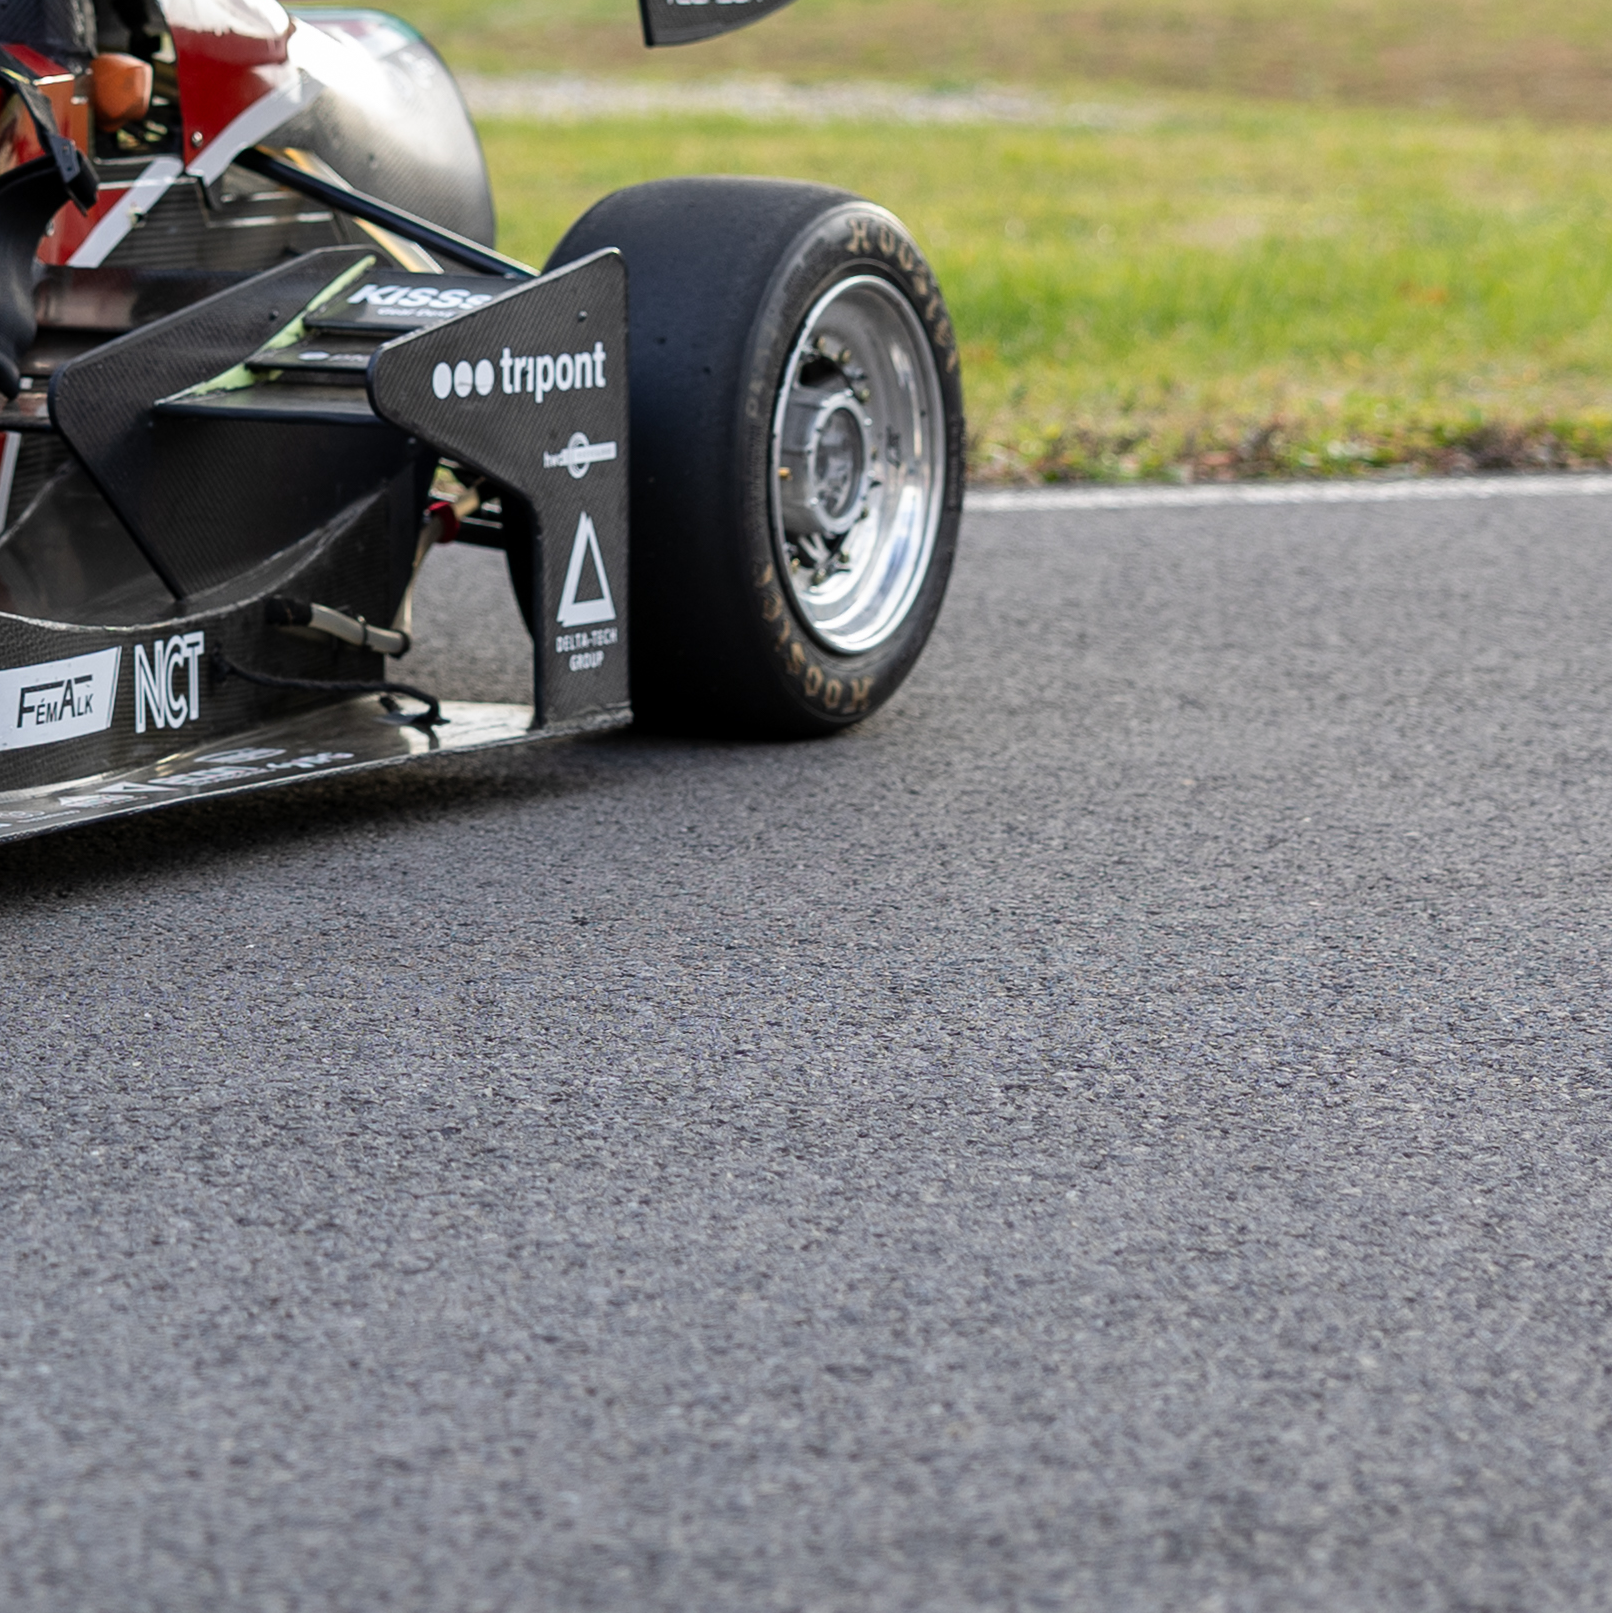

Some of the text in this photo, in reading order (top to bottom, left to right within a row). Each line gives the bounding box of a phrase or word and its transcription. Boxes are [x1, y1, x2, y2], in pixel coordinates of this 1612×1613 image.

[500, 342, 607, 403] tripont
[556, 627, 618, 653] DELTA-TECH
[569, 650, 605, 672] GROUP
[134, 630, 205, 734] NCT
